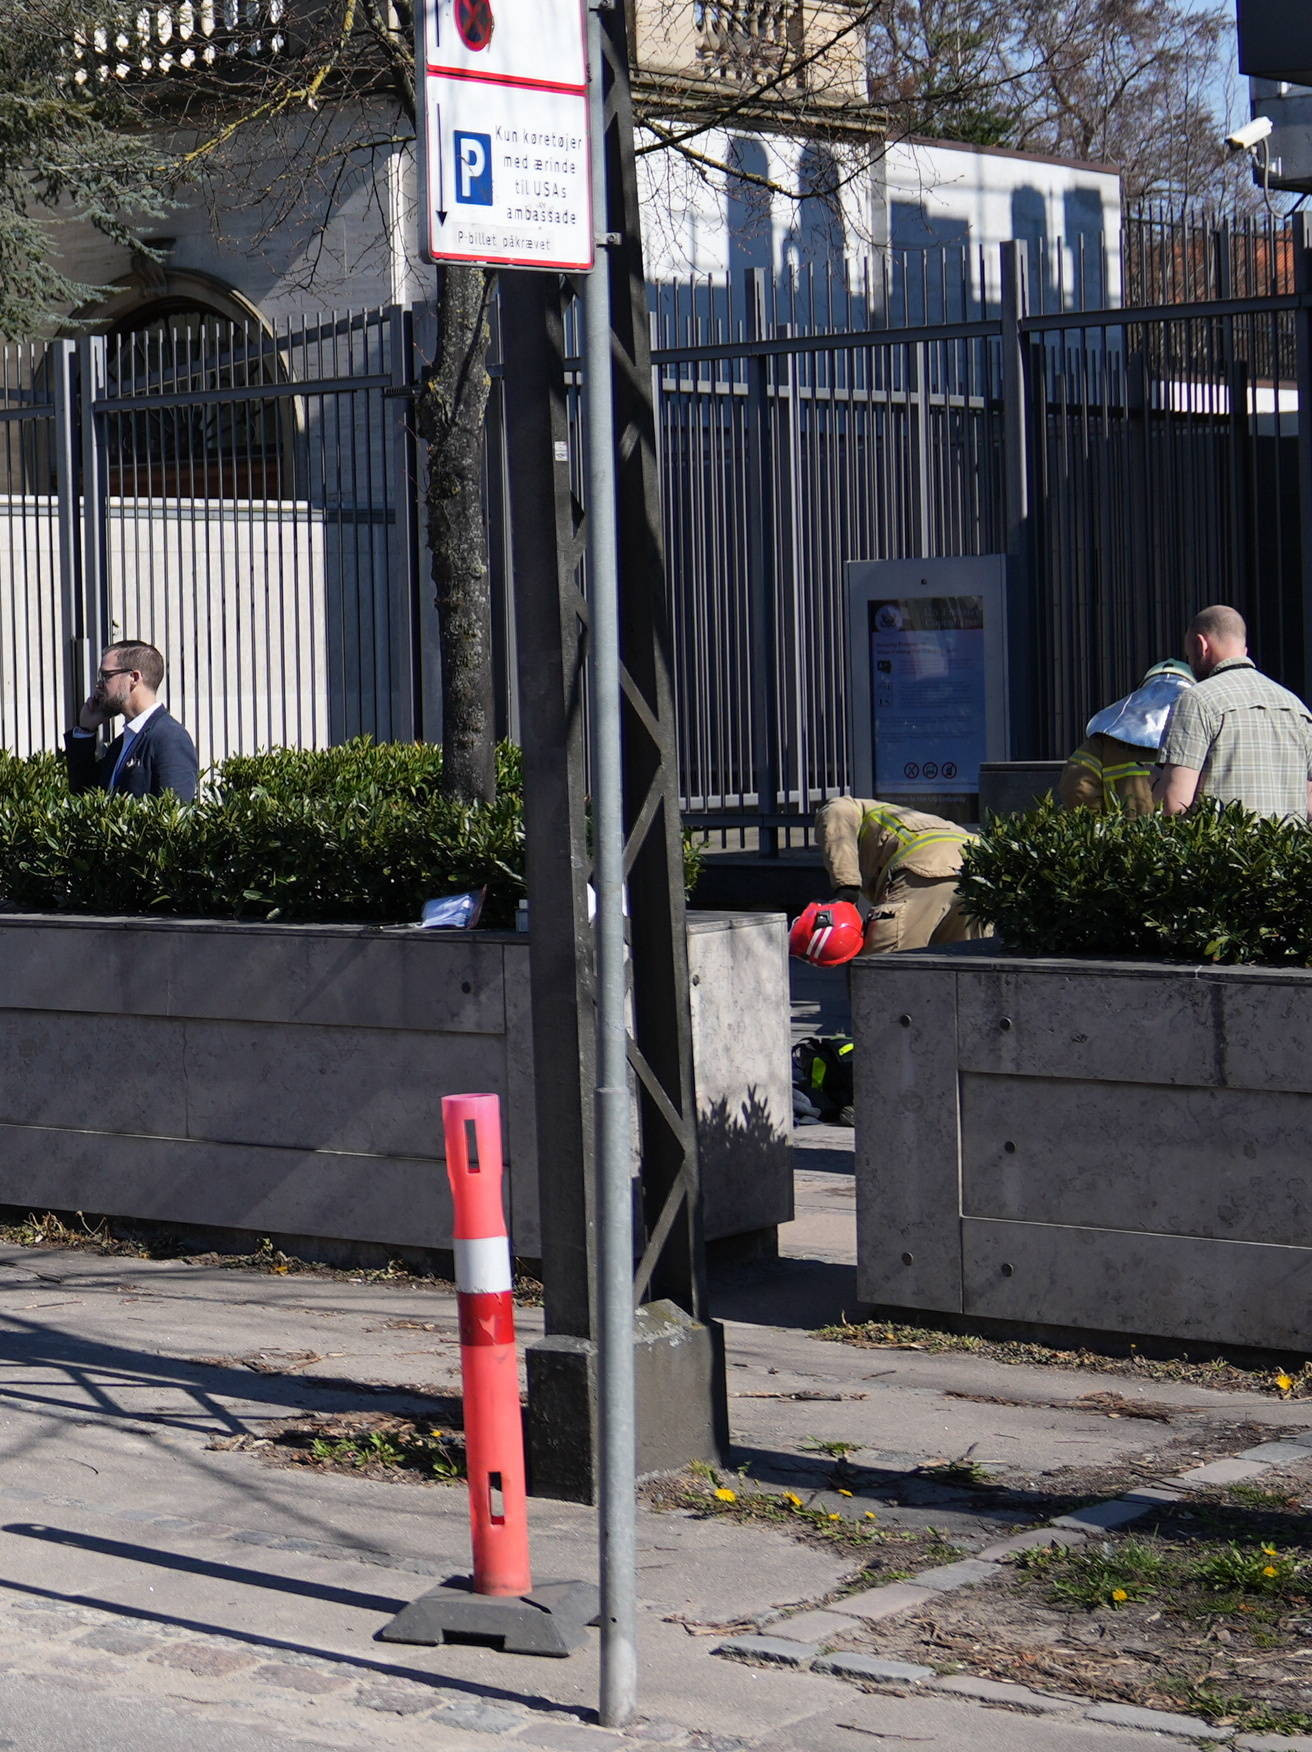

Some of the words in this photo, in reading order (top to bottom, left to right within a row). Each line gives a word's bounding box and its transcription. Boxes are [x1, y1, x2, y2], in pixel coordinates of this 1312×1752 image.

[495, 125, 518, 142] Kun
[523, 128, 583, 151] køretøjer
[461, 138, 485, 197] P
[504, 155, 529, 169] med
[534, 157, 576, 174] ærinde
[515, 180, 529, 196] til
[533, 181, 567, 198] USAs
[507, 206, 577, 225] ambassade
[458, 231, 496, 246] P-billet
[503, 235, 551, 252] påkrævet
